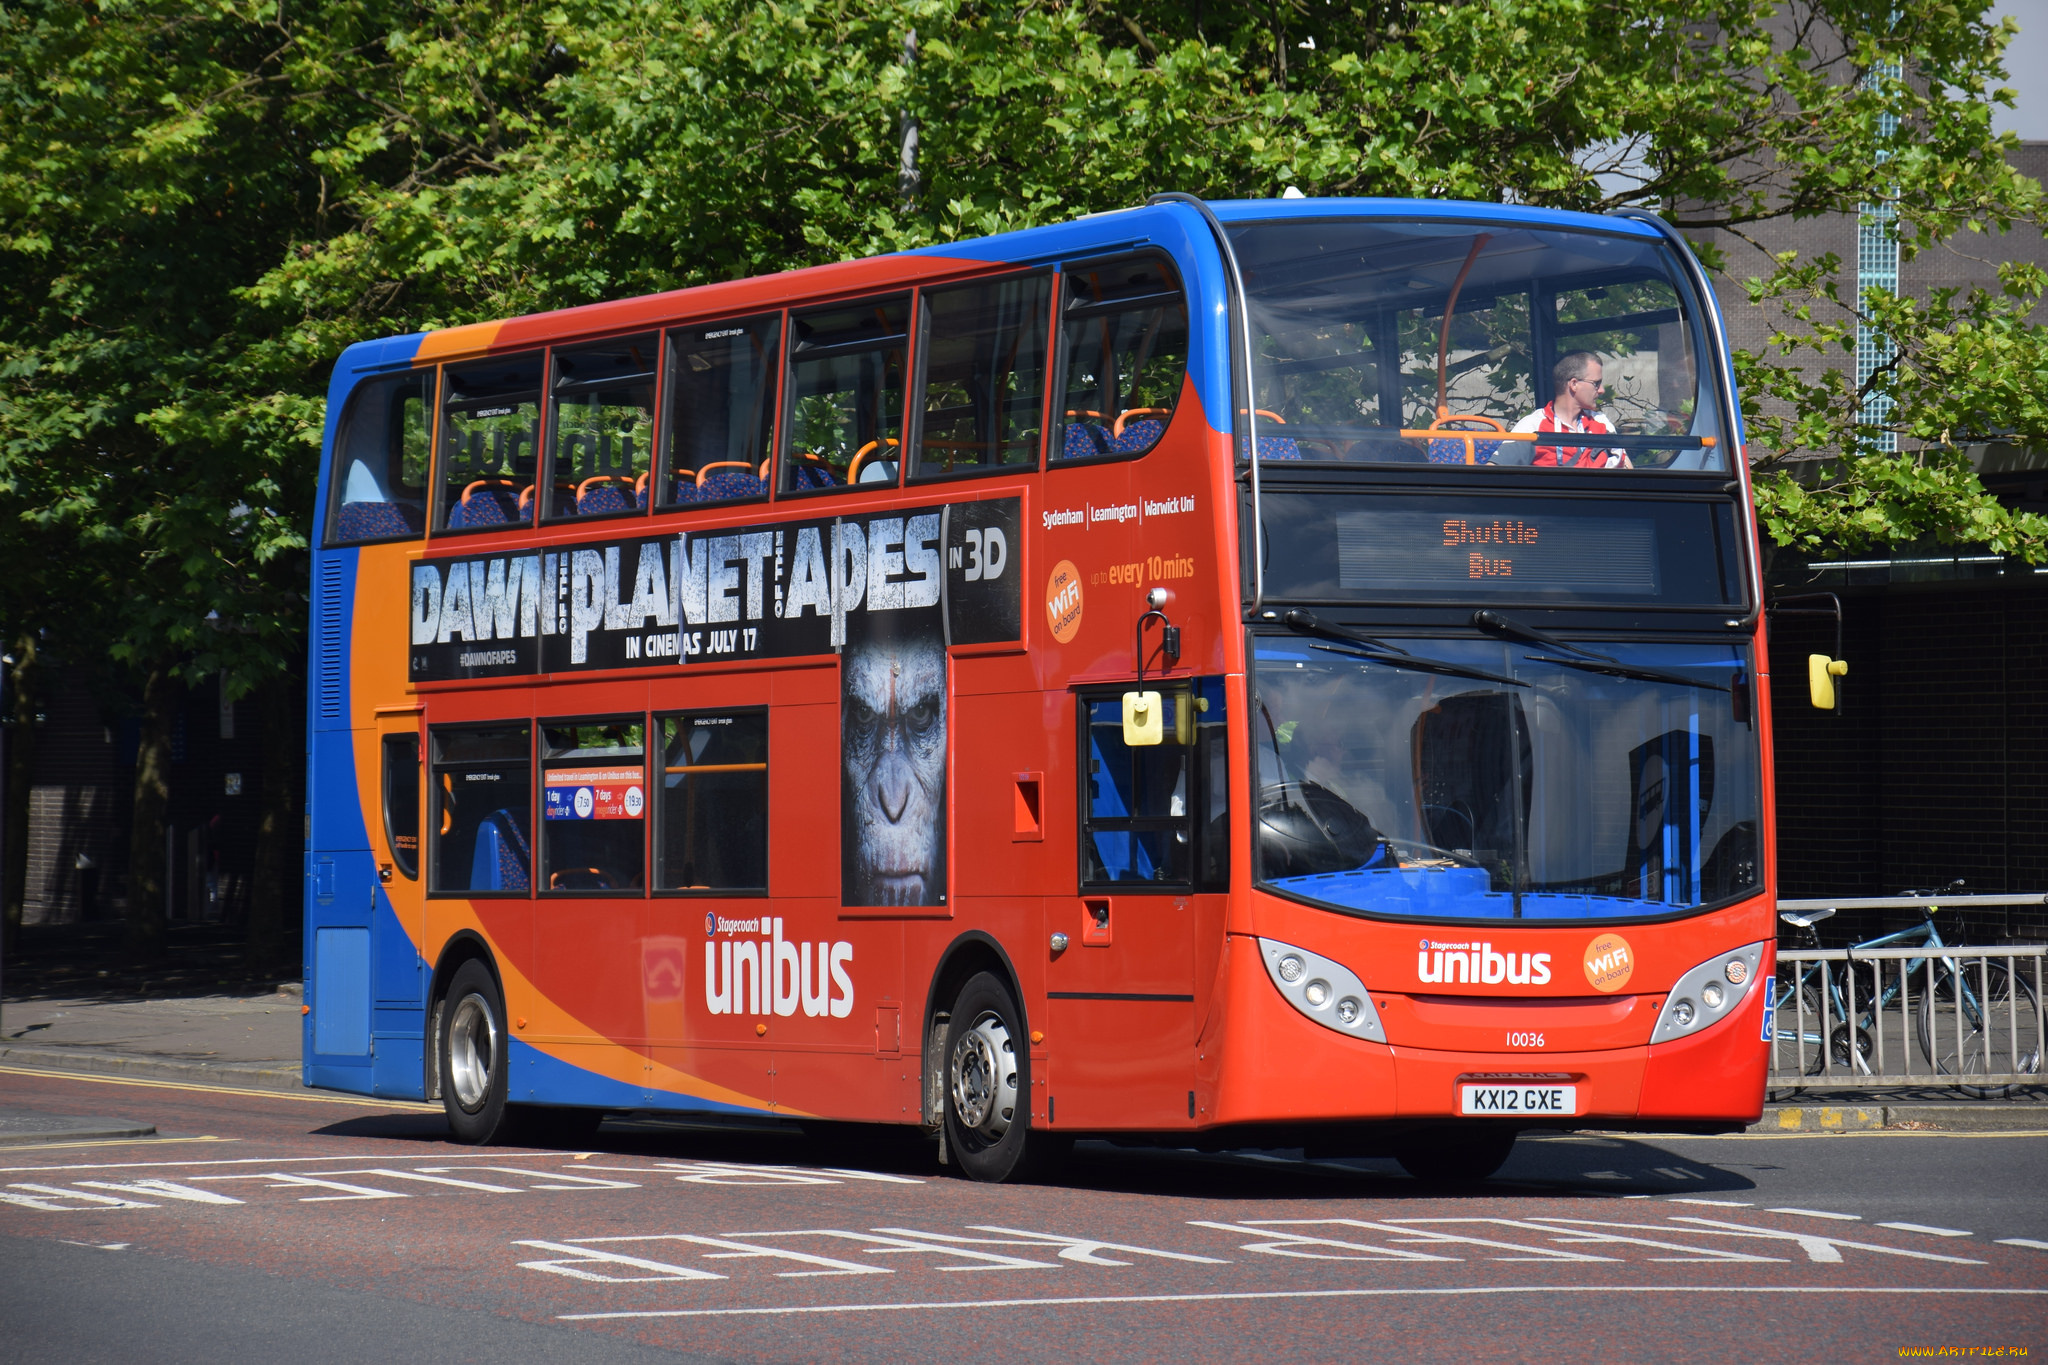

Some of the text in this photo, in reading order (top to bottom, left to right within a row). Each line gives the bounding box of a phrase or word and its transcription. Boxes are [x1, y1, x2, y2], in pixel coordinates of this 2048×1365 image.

[1042, 494, 1195, 531] Sydenham Leamington Warwick Uni
[1443, 519, 1539, 546] Shuttle
[1090, 553, 1195, 589] up to every 10 mins
[1469, 552, 1513, 579] Bus
[411, 552, 558, 646] DAWN
[570, 531, 774, 665] PLANET
[784, 513, 941, 647] APES
[949, 546, 963, 570] IN
[965, 526, 1007, 582] 3D
[1054, 572, 1067, 588] free
[1048, 579, 1080, 620] WiFi
[1053, 602, 1081, 635] on board
[625, 627, 757, 659] IN CINEMAS JULY 17
[459, 649, 516, 667] #DAWNOFAPES
[551, 790, 560, 804] day
[595, 788, 612, 803] 7 days
[716, 916, 759, 937] Stagecoach
[1430, 941, 1470, 952] Stagecoach
[1595, 942, 1612, 953] free
[705, 916, 855, 1019] unibus
[1418, 942, 1552, 985] unibus
[1586, 947, 1629, 976] WiFi
[1594, 963, 1630, 986] on board
[1505, 1032, 1545, 1047] 10036
[1474, 1089, 1563, 1110] KX12 GXE
